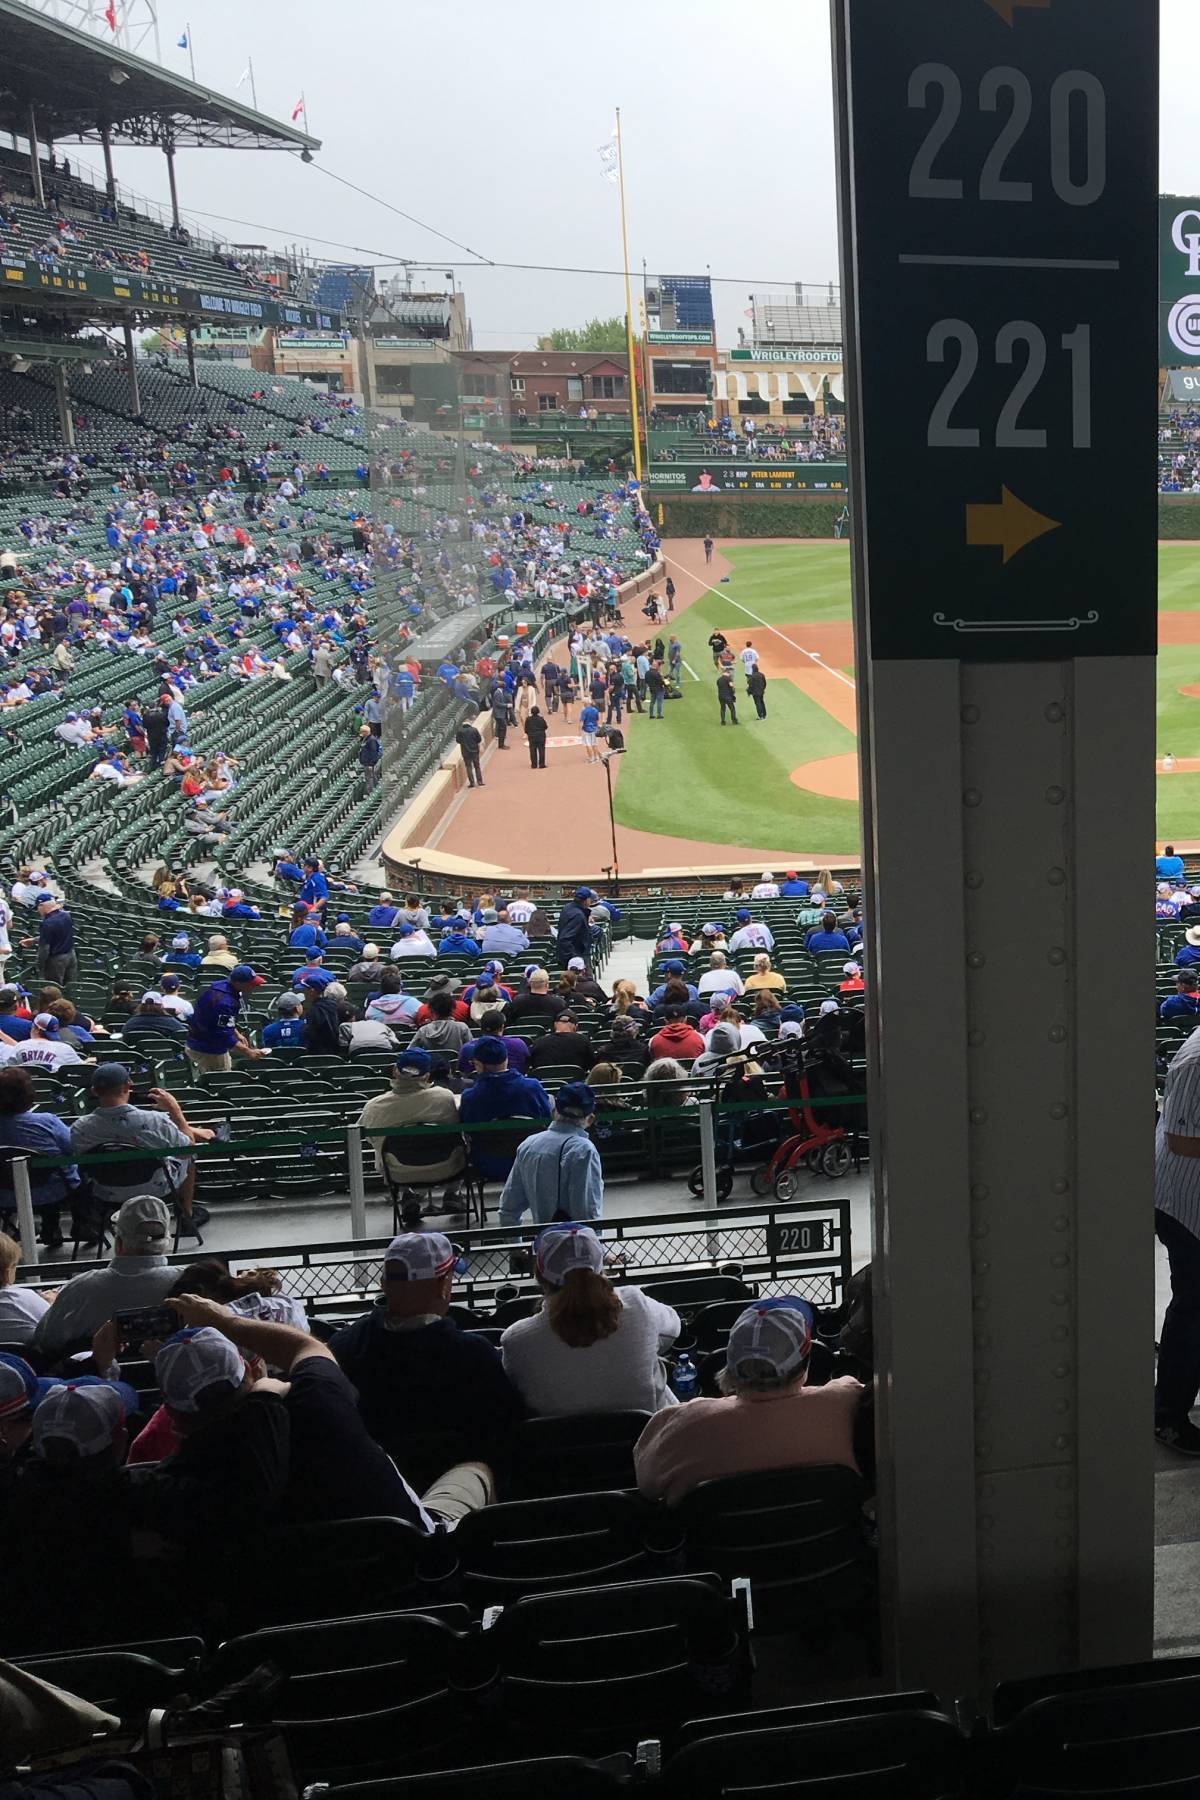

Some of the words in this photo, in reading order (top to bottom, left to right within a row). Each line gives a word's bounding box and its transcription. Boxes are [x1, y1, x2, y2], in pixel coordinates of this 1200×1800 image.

[907, 62, 1107, 206] 220
[926, 319, 1092, 449] 221
[21, 1049, 57, 1064] BRYANT
[780, 1227, 810, 1251] 220
